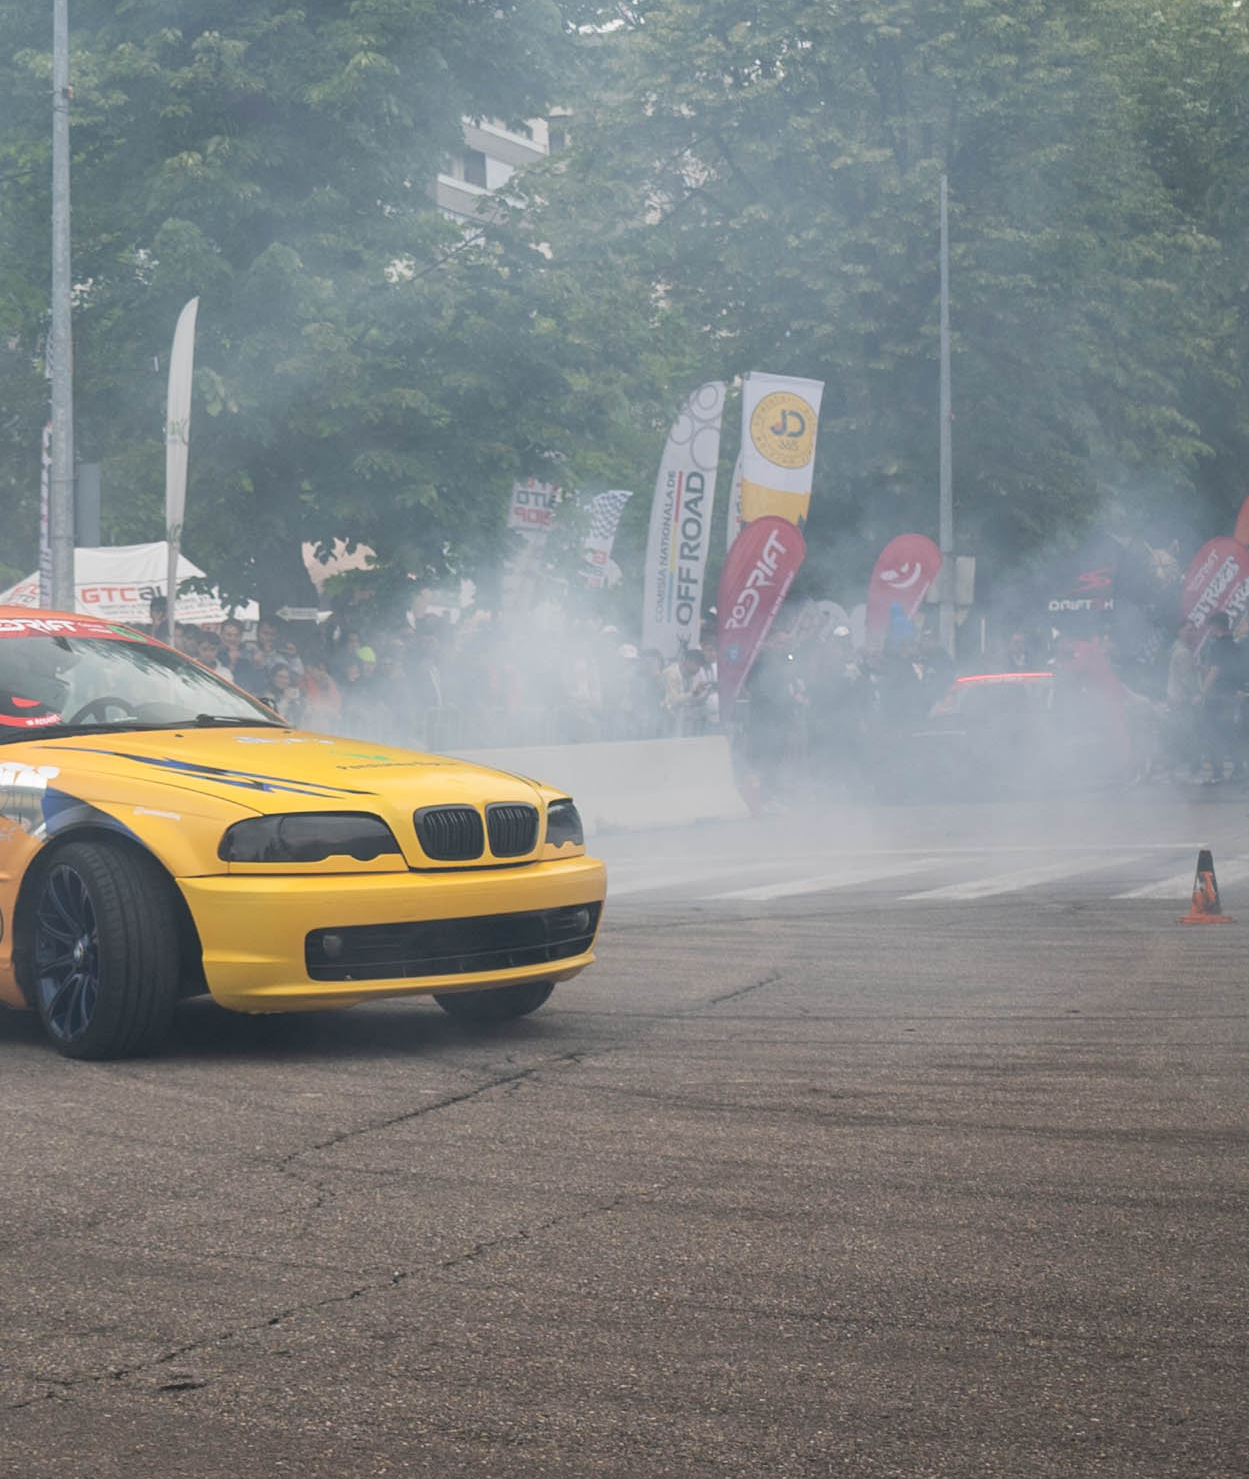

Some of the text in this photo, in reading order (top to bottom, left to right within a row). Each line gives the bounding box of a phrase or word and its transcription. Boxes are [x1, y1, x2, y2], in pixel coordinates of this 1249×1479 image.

[658, 489, 674, 567] NATIONALA
[679, 471, 705, 562] ROAD
[676, 567, 698, 626] OFF
